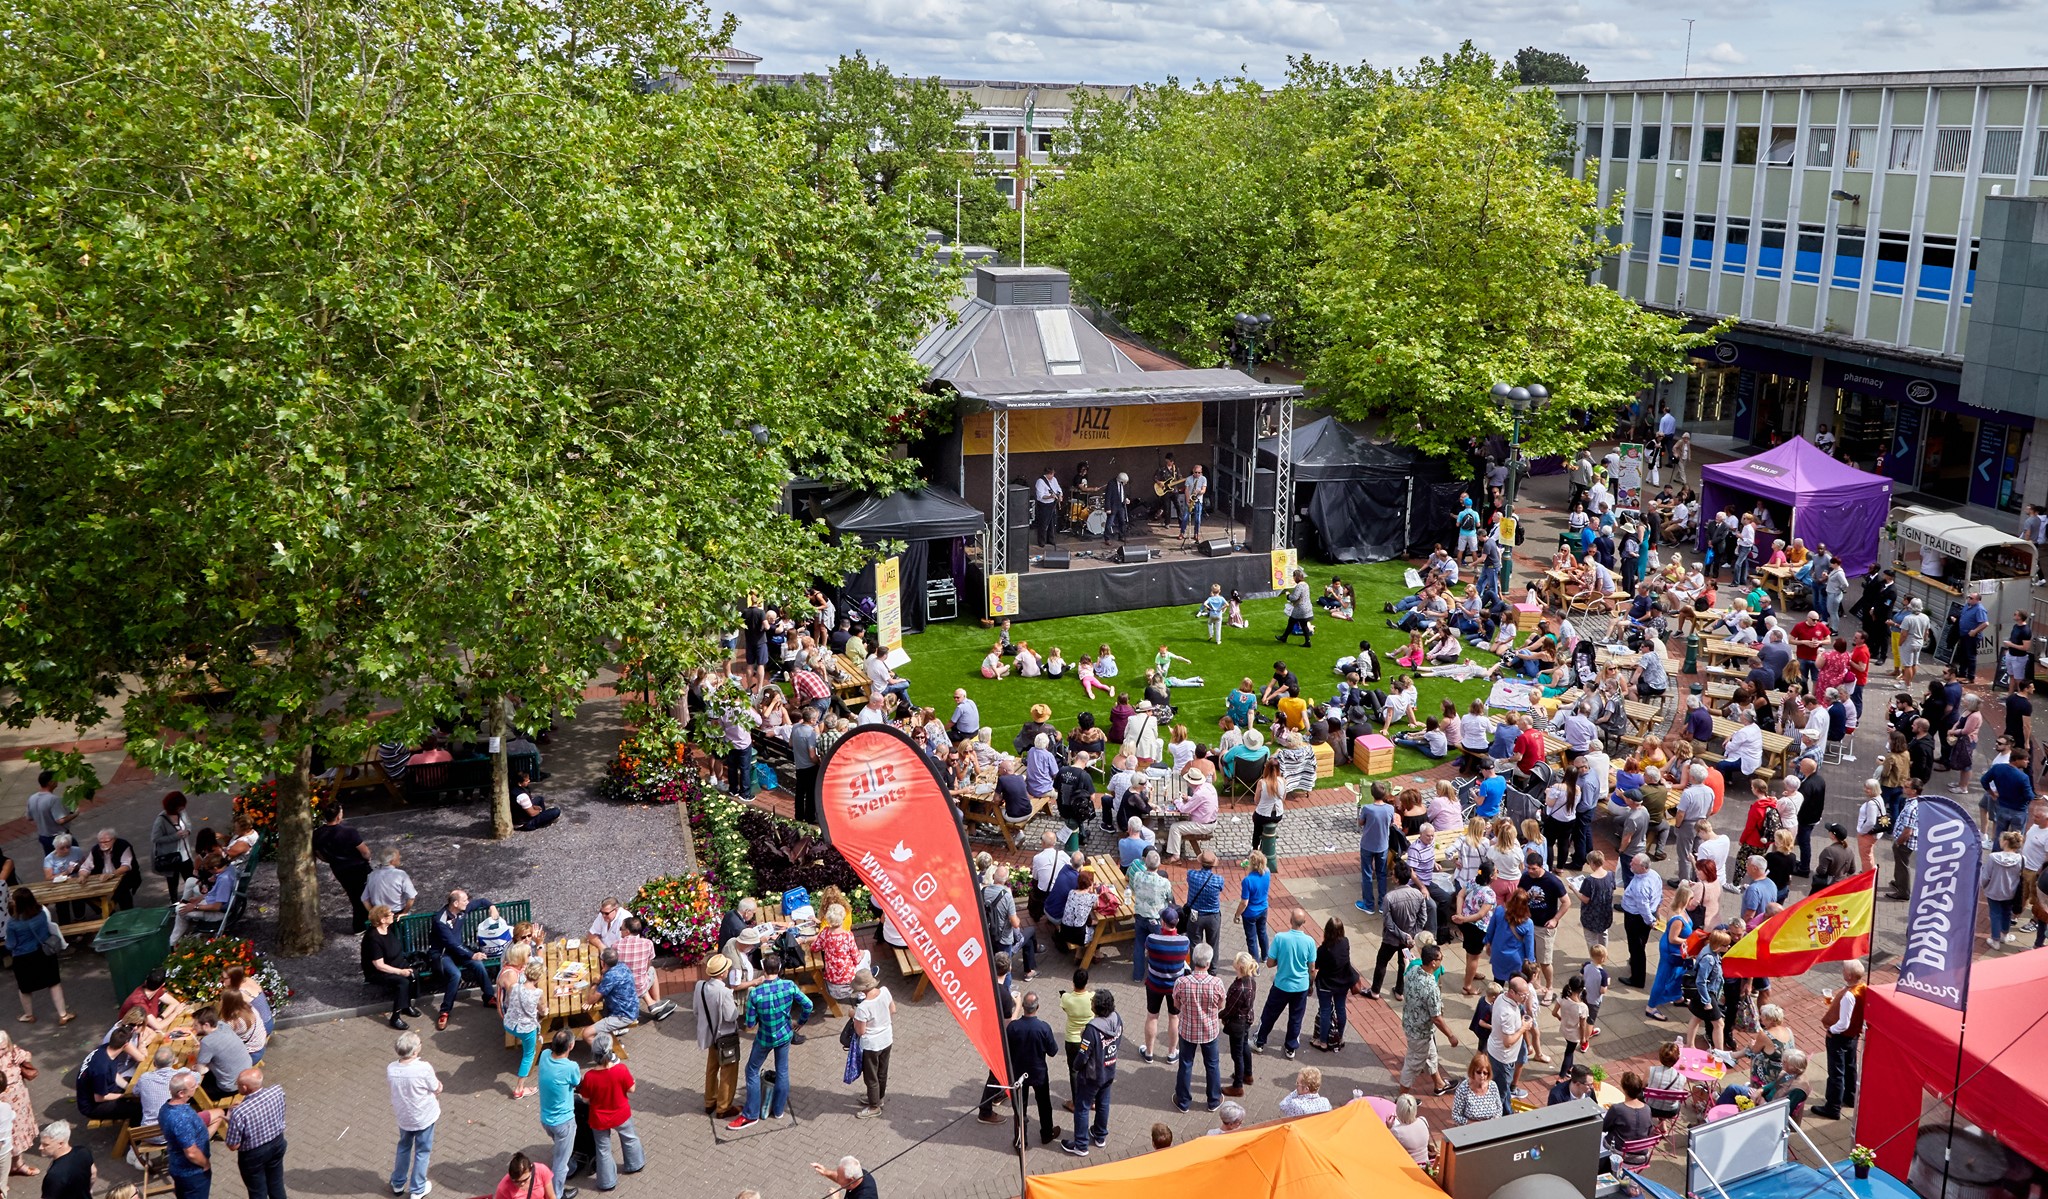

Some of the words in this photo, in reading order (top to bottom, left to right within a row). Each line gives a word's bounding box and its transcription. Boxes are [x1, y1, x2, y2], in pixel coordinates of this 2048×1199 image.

[1844, 373, 1884, 389] pharmacy
[1073, 407, 1112, 433] JAZZ
[1079, 430, 1111, 440] FESTIVAL
[1905, 527, 1922, 542] GIN
[1924, 534, 1962, 558] TRAILER
[847, 786, 906, 820] Events
[860, 851, 978, 1020] WWW.RREVENTS.CO.UK
[1513, 1150, 1530, 1162] BT
